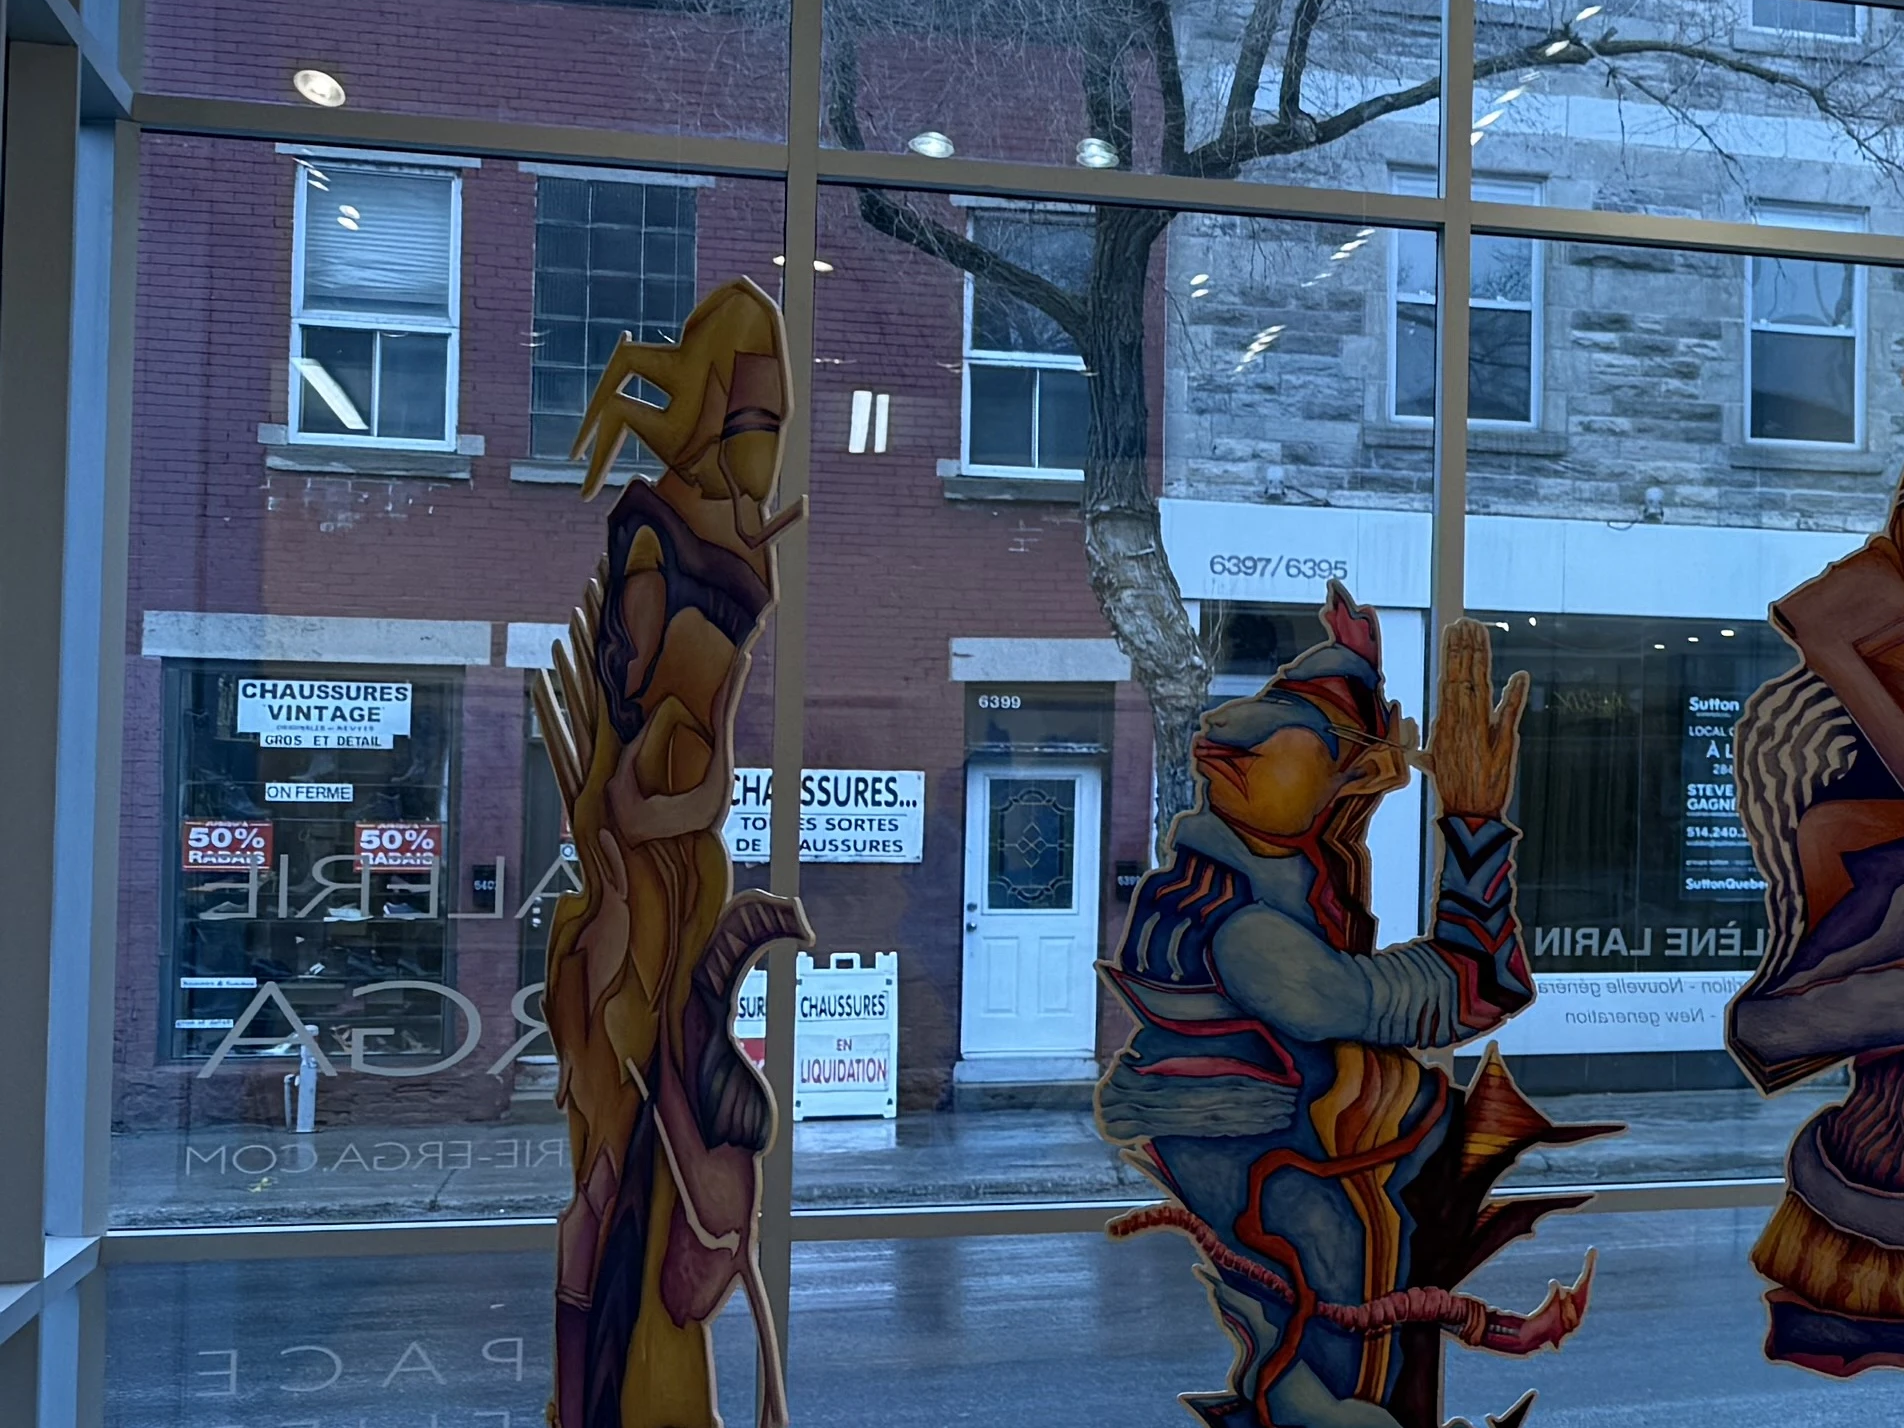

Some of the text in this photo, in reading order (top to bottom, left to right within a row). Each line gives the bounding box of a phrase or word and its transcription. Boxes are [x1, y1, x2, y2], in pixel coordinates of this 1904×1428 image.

[1209, 554, 1348, 580] 6397/6395
[241, 683, 409, 702] CHAUSSURES
[978, 695, 1021, 709] 6399
[1689, 696, 1740, 711] Sutton
[1688, 726, 1726, 737] LOCAL
[265, 735, 382, 746] GROS ET DETAIL
[1725, 743, 1734, 759] L
[267, 786, 351, 800] ON FERME
[731, 775, 917, 808] CHASSURES...
[1687, 783, 1734, 796] STEVE
[825, 818, 899, 832] SORTES
[188, 827, 265, 848] 50%
[360, 829, 435, 850] 50%
[736, 838, 903, 853] DE AUSSURES
[739, 996, 766, 1018] SUR
[800, 993, 886, 1018] CHAUSSURES
[836, 1039, 853, 1051] EN
[801, 1058, 887, 1084] LIQUIDATION
